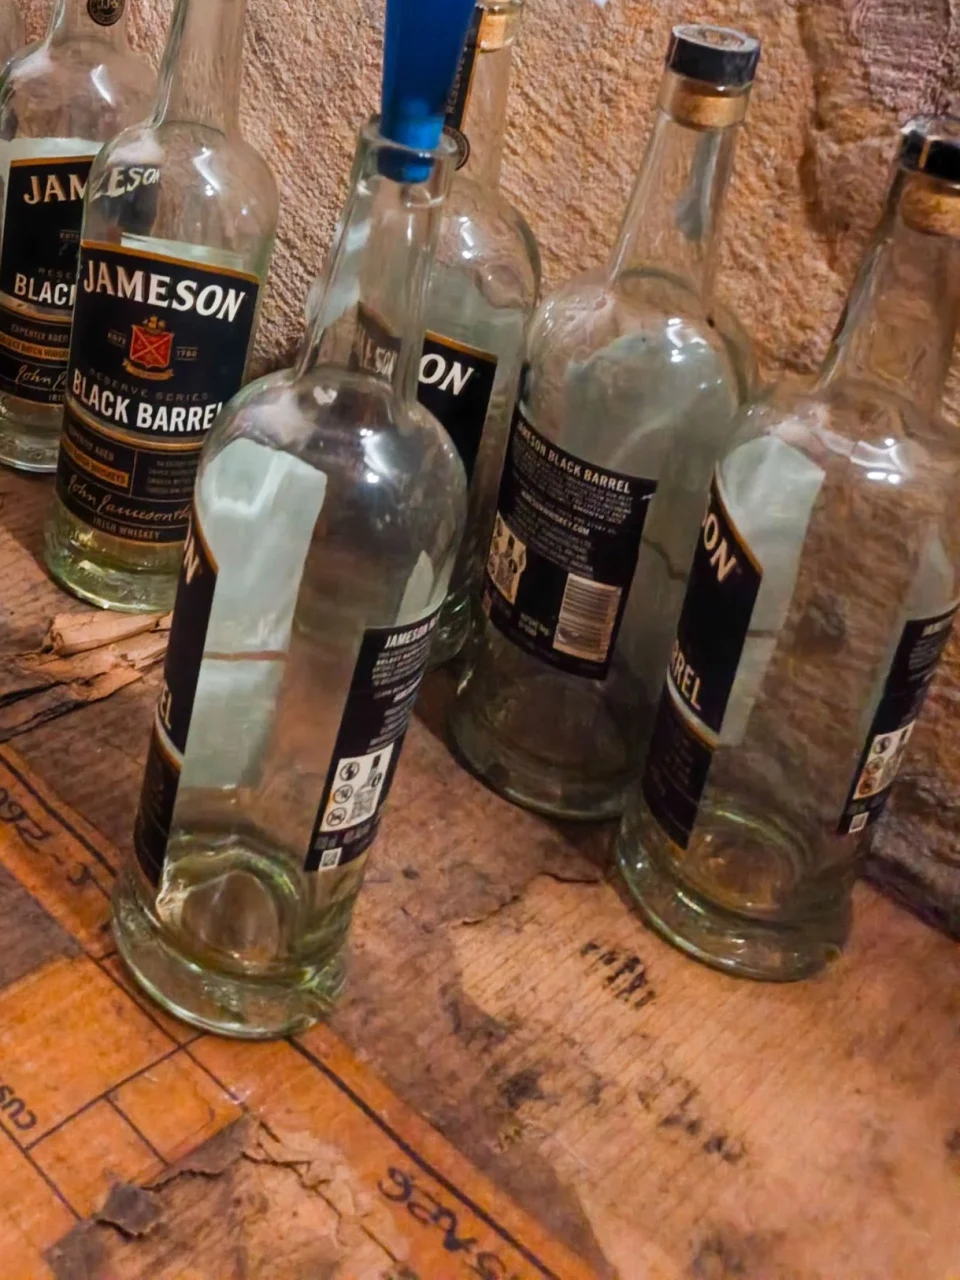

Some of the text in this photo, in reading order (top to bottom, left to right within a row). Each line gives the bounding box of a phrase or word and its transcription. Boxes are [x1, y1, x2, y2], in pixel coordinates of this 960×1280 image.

[83, 259, 246, 323] JAMESON
[72, 368, 131, 424] BLACK
[548, 449, 583, 478] BLACK
[584, 470, 632, 495] BARREL
[92, 515, 161, 541] IRISH WHISKEY
